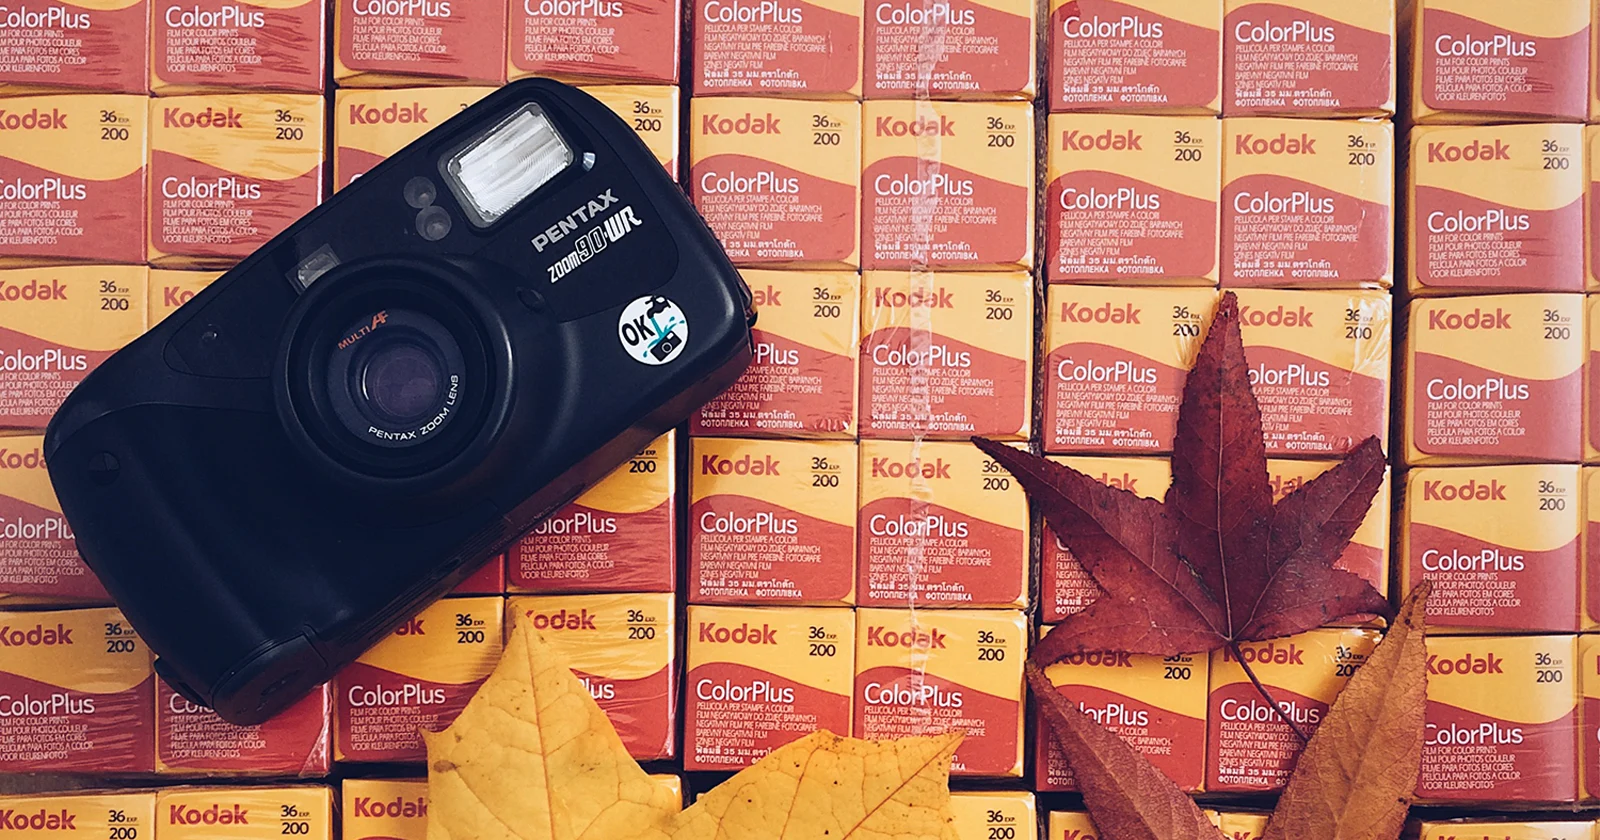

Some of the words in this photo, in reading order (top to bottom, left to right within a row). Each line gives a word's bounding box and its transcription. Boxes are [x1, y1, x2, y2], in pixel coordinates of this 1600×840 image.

[165, 6, 265, 28] ColorPlus
[353, 0, 451, 17] ColorPlus
[524, 0, 623, 17] ColorPlus
[704, 1, 802, 22] ColorPlus
[875, 3, 975, 24] ColorPlus
[1063, 16, 1163, 38] ColorPlus
[1235, 21, 1335, 42] ColorPlus
[1435, 35, 1536, 56] ColorPlus
[100, 110, 117, 122] 36
[275, 110, 292, 122] 36
[350, 102, 428, 124] Kodak
[633, 101, 650, 113] 36
[164, 108, 242, 128] Kodak
[634, 119, 661, 132] 200
[702, 113, 780, 134] Kodak
[812, 115, 829, 127] 36
[876, 116, 955, 137] Kodak
[987, 117, 1003, 129] 36
[101, 128, 129, 140] 200
[276, 128, 303, 140] 200
[813, 133, 840, 145] 200
[987, 135, 1014, 147] 200
[1062, 129, 1142, 150] Kodak
[1174, 131, 1190, 143] 36
[1235, 134, 1316, 155] Kodak
[1428, 140, 1510, 162] Kodak
[1174, 149, 1201, 161] 200
[0, 178, 86, 200] olorPlus
[162, 177, 261, 199] ColorPlus
[701, 172, 799, 193] ColorPlus
[875, 174, 973, 195] ColorPlus
[1060, 188, 1160, 210] ColorPlus
[1234, 192, 1334, 213] ColorPlus
[531, 189, 619, 252] PENTAX
[1427, 210, 1530, 233] ColorPlus
[100, 281, 116, 293] 36
[813, 288, 829, 300] 36
[985, 290, 1002, 302] 36
[101, 298, 129, 310] 200
[875, 287, 953, 308] Kodak
[814, 305, 840, 318] 200
[986, 308, 1012, 320] 200
[1061, 302, 1141, 324] Kodak
[1429, 308, 1511, 330] Kodak
[1543, 310, 1560, 322] 36
[338, 326, 370, 349] MULTI
[622, 314, 655, 346] OK
[1544, 327, 1570, 339] 200
[0, 349, 87, 371] olorPlus
[873, 345, 971, 367] ColorPlus
[1058, 360, 1157, 383] ColorPlus
[1249, 363, 1329, 386] olorPlus
[1427, 378, 1529, 400] ColorPlus
[368, 426, 416, 440] PENTAX
[420, 408, 450, 434] ZOOM
[447, 375, 458, 405] LENS
[702, 455, 780, 476] Kodak
[812, 458, 828, 470] 36
[872, 458, 951, 479] Kodak
[812, 475, 839, 487] 200
[1424, 479, 1506, 500] Kodak
[1539, 481, 1555, 493] 36
[1539, 498, 1565, 510] 200
[528, 513, 616, 535] olorPlus
[701, 512, 798, 533] ColorPlus
[870, 515, 968, 537] ColorPlus
[1422, 549, 1524, 571] ColorPlus
[455, 614, 473, 627] 36
[527, 609, 595, 631] odak
[627, 610, 644, 623] 36
[104, 623, 122, 636] 36
[457, 631, 485, 643] 200
[628, 627, 655, 639] 200
[699, 623, 777, 645] Kodak
[809, 627, 825, 639] 36
[867, 627, 946, 648] Kodak
[977, 631, 994, 643] 36
[107, 640, 135, 653] 200
[809, 644, 836, 656] 200
[978, 648, 1004, 661] 200
[1535, 653, 1551, 665] 36
[1537, 671, 1562, 683] 200
[349, 684, 445, 706] ColorPlus
[696, 679, 794, 702] ColorPlus
[864, 683, 962, 707] ColorPlus
[0, 694, 95, 716] ColorPlus
[1220, 699, 1320, 723] ColorPlus
[0, 810, 76, 830] Kodak
[108, 810, 125, 823] 36
[170, 805, 248, 825] Kodak
[280, 805, 298, 818] 36
[987, 811, 1003, 823] 36
[109, 827, 137, 840] 200
[282, 822, 309, 835] 200
[989, 828, 1015, 840] 200
